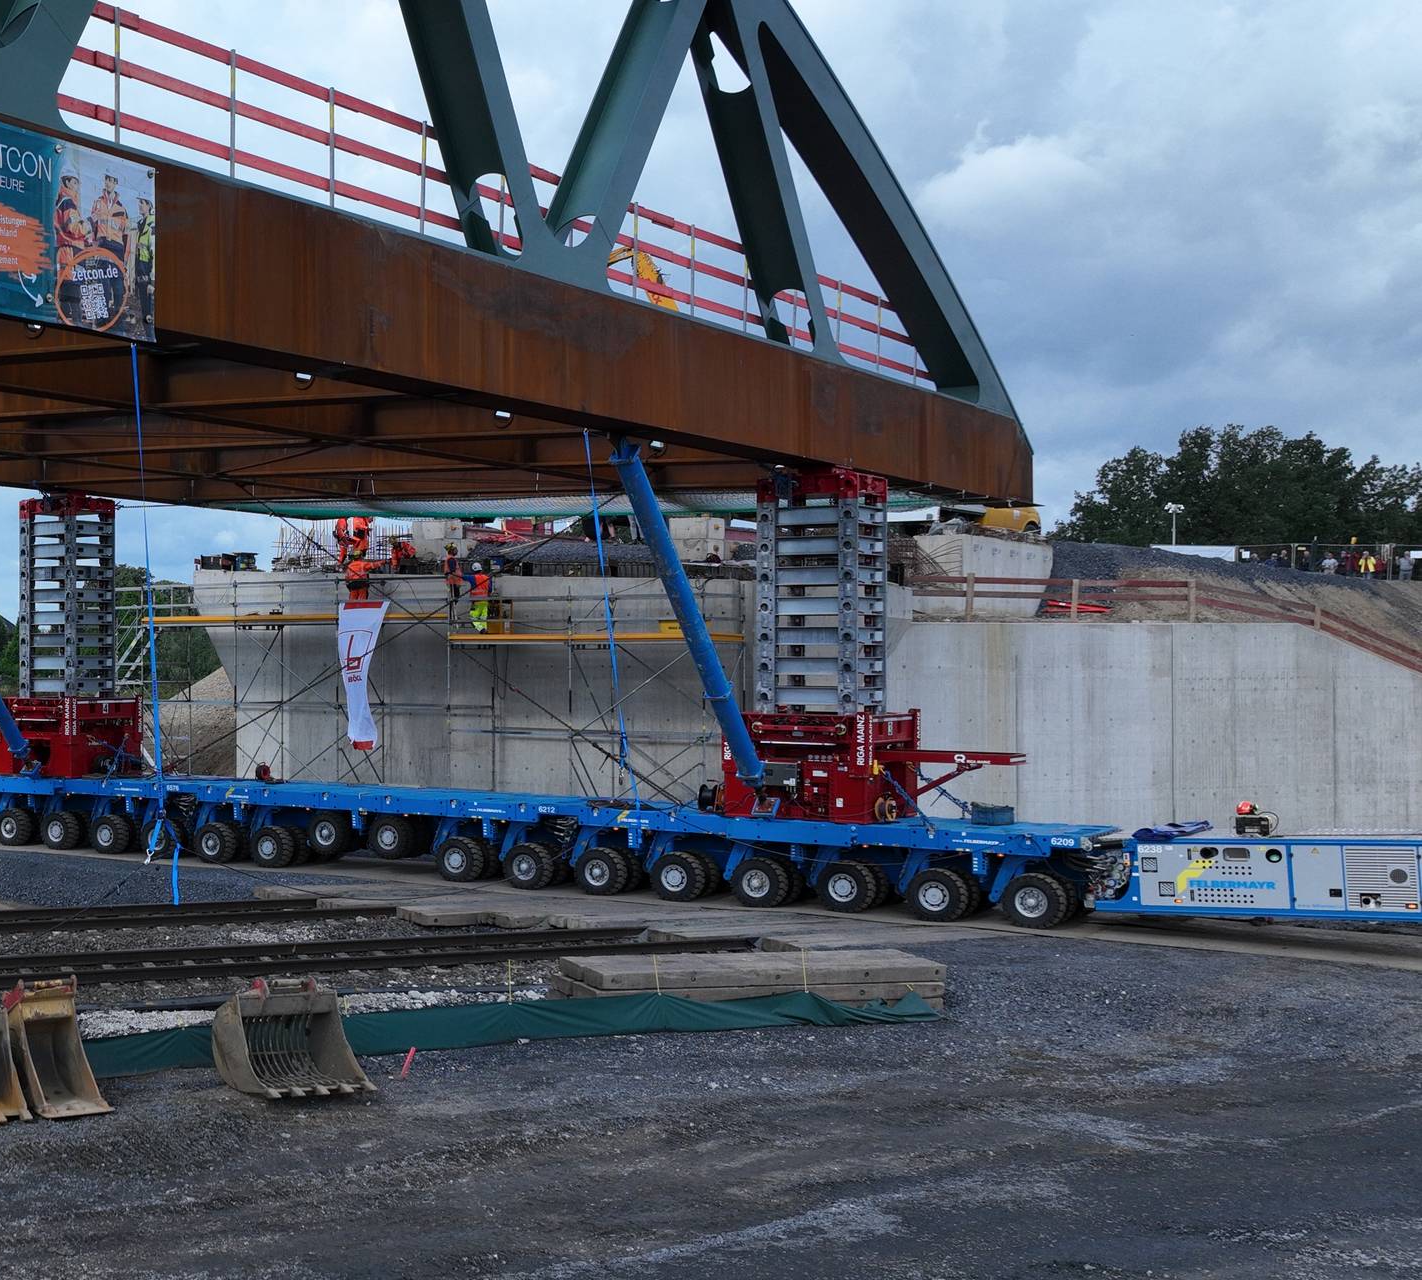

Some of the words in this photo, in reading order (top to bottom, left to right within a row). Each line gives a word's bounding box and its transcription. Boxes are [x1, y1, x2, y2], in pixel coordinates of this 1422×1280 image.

[72, 264, 119, 282] zetcon.de
[856, 714, 865, 744] MAINZ
[856, 745, 865, 766] RIGA
[537, 806, 556, 814] 6212
[1051, 837, 1075, 847] 6209
[1138, 844, 1163, 854] 6238
[1188, 879, 1276, 890] FELBERMAYR
